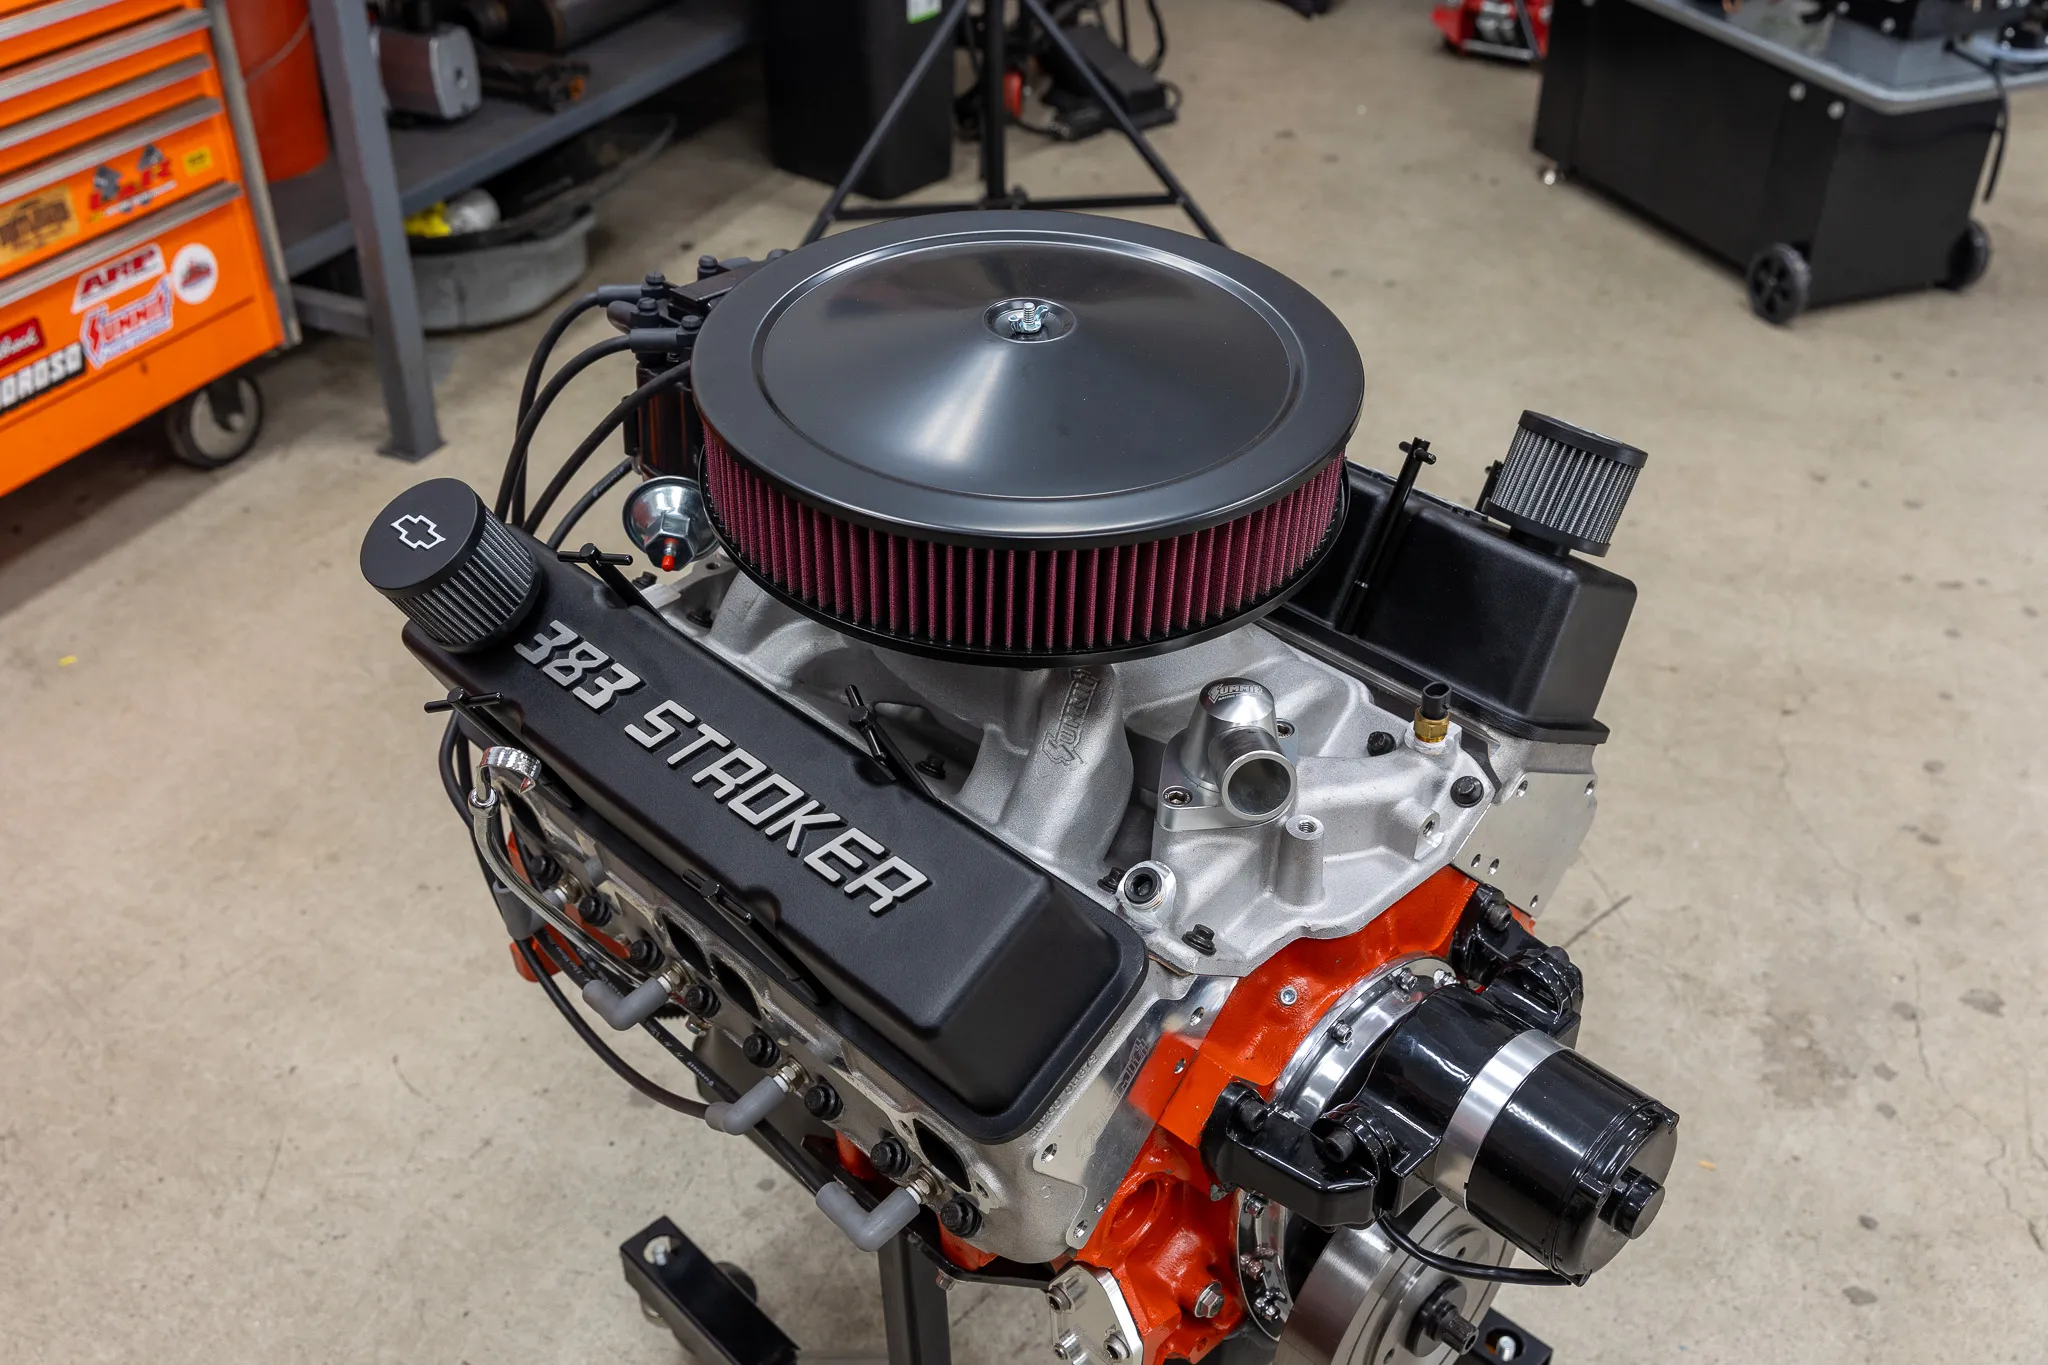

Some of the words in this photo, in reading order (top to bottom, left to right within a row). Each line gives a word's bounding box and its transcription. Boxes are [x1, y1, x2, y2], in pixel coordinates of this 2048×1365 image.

[82, 248, 158, 300] ARP
[512, 619, 642, 710] 383
[624, 699, 929, 914] STROKER
